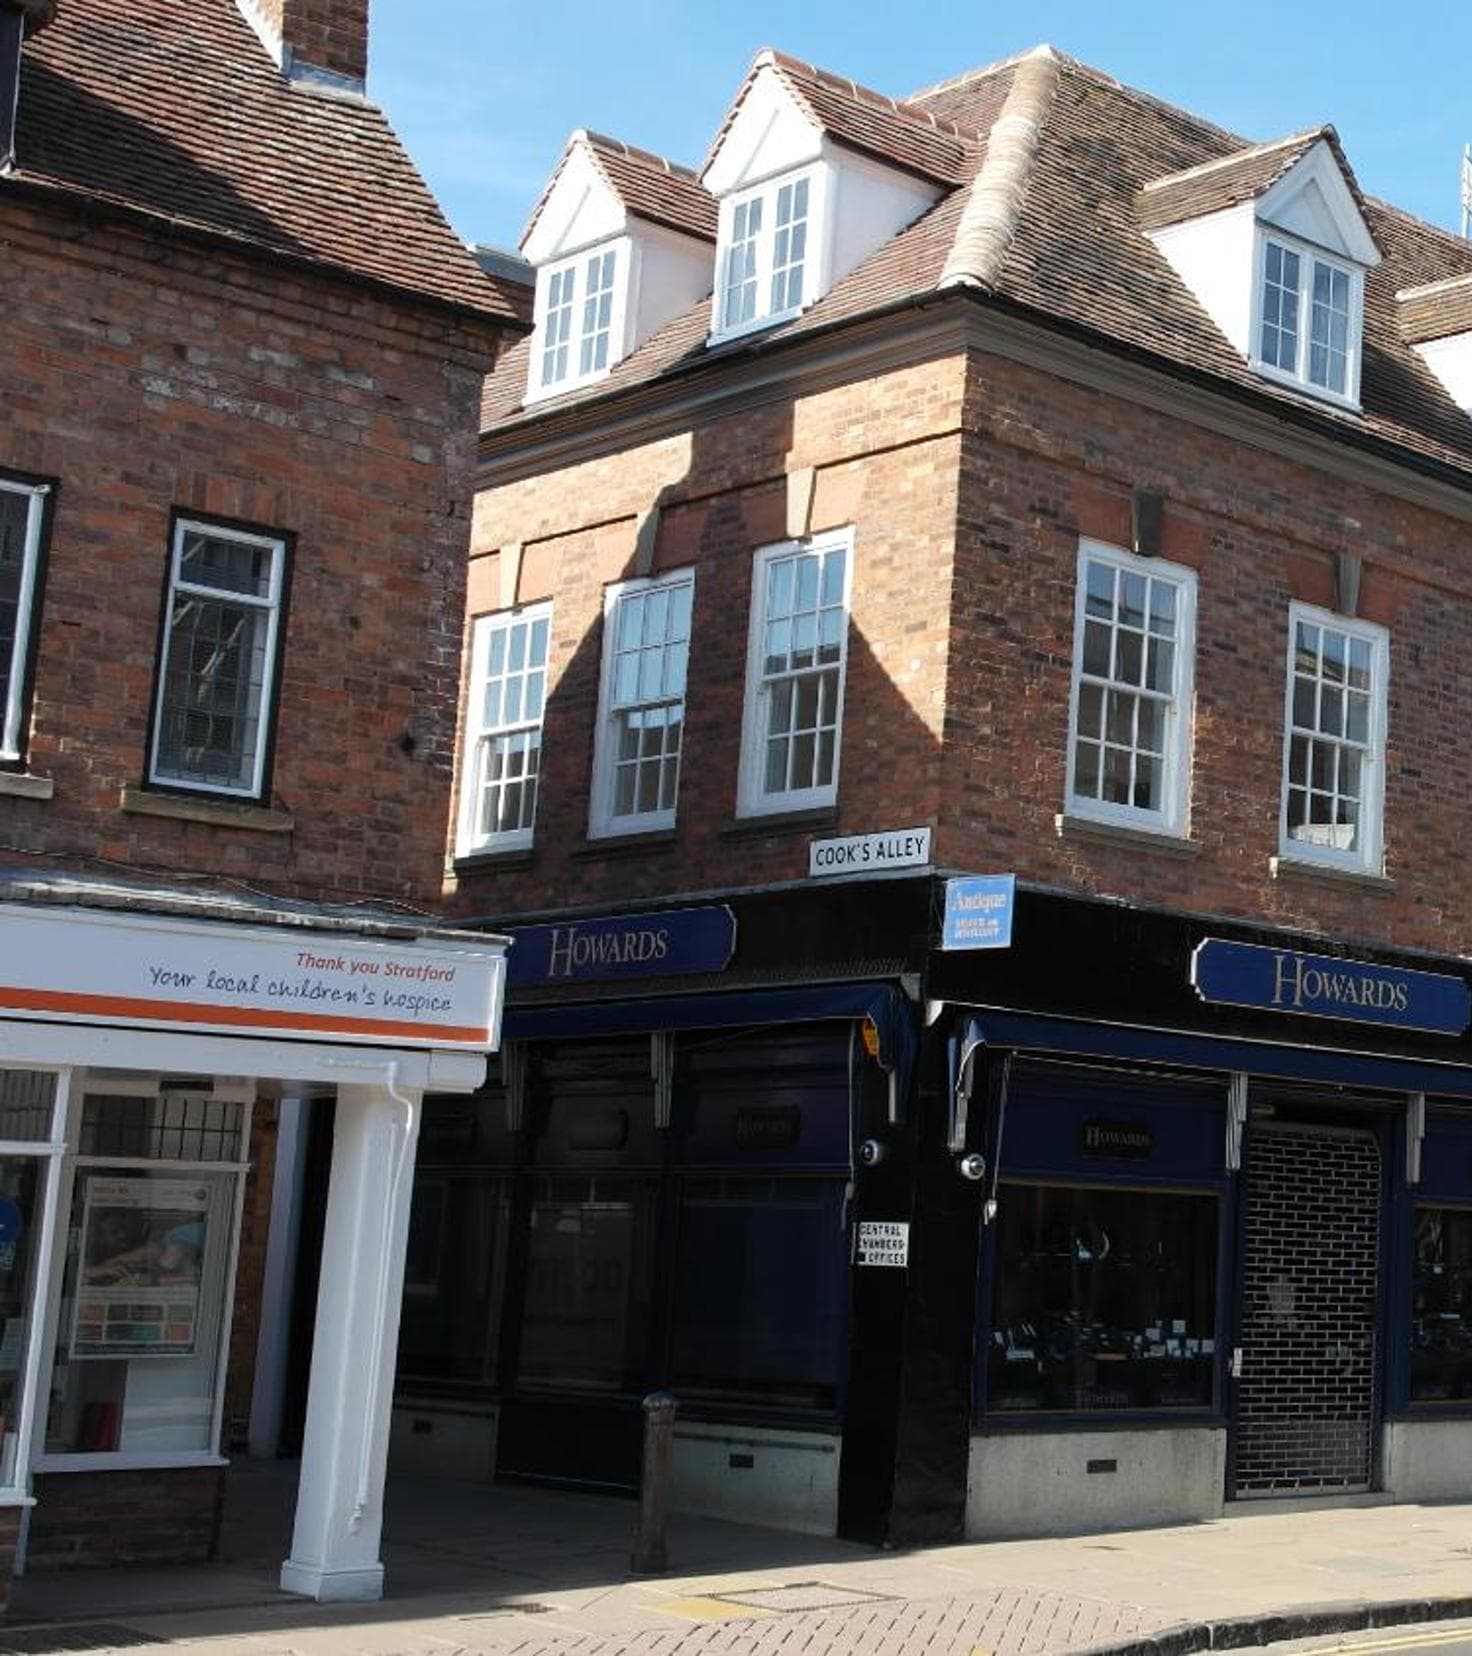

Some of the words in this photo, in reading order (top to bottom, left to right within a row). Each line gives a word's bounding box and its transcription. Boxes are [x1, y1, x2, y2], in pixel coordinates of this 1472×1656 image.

[815, 842, 871, 867] COOK'S
[875, 835, 926, 860] ALLEY
[296, 952, 345, 971] Thank
[349, 960, 379, 976] you
[383, 962, 456, 983] Stratford
[548, 927, 669, 977] HOWARDS
[149, 966, 196, 988] Your
[205, 969, 260, 994] local
[267, 977, 376, 1006] children's
[383, 990, 453, 1017] hospice
[1271, 955, 1408, 1012] HOWARDS
[860, 1223, 902, 1236] CENTRAL
[868, 1252, 905, 1265] OFFICES
